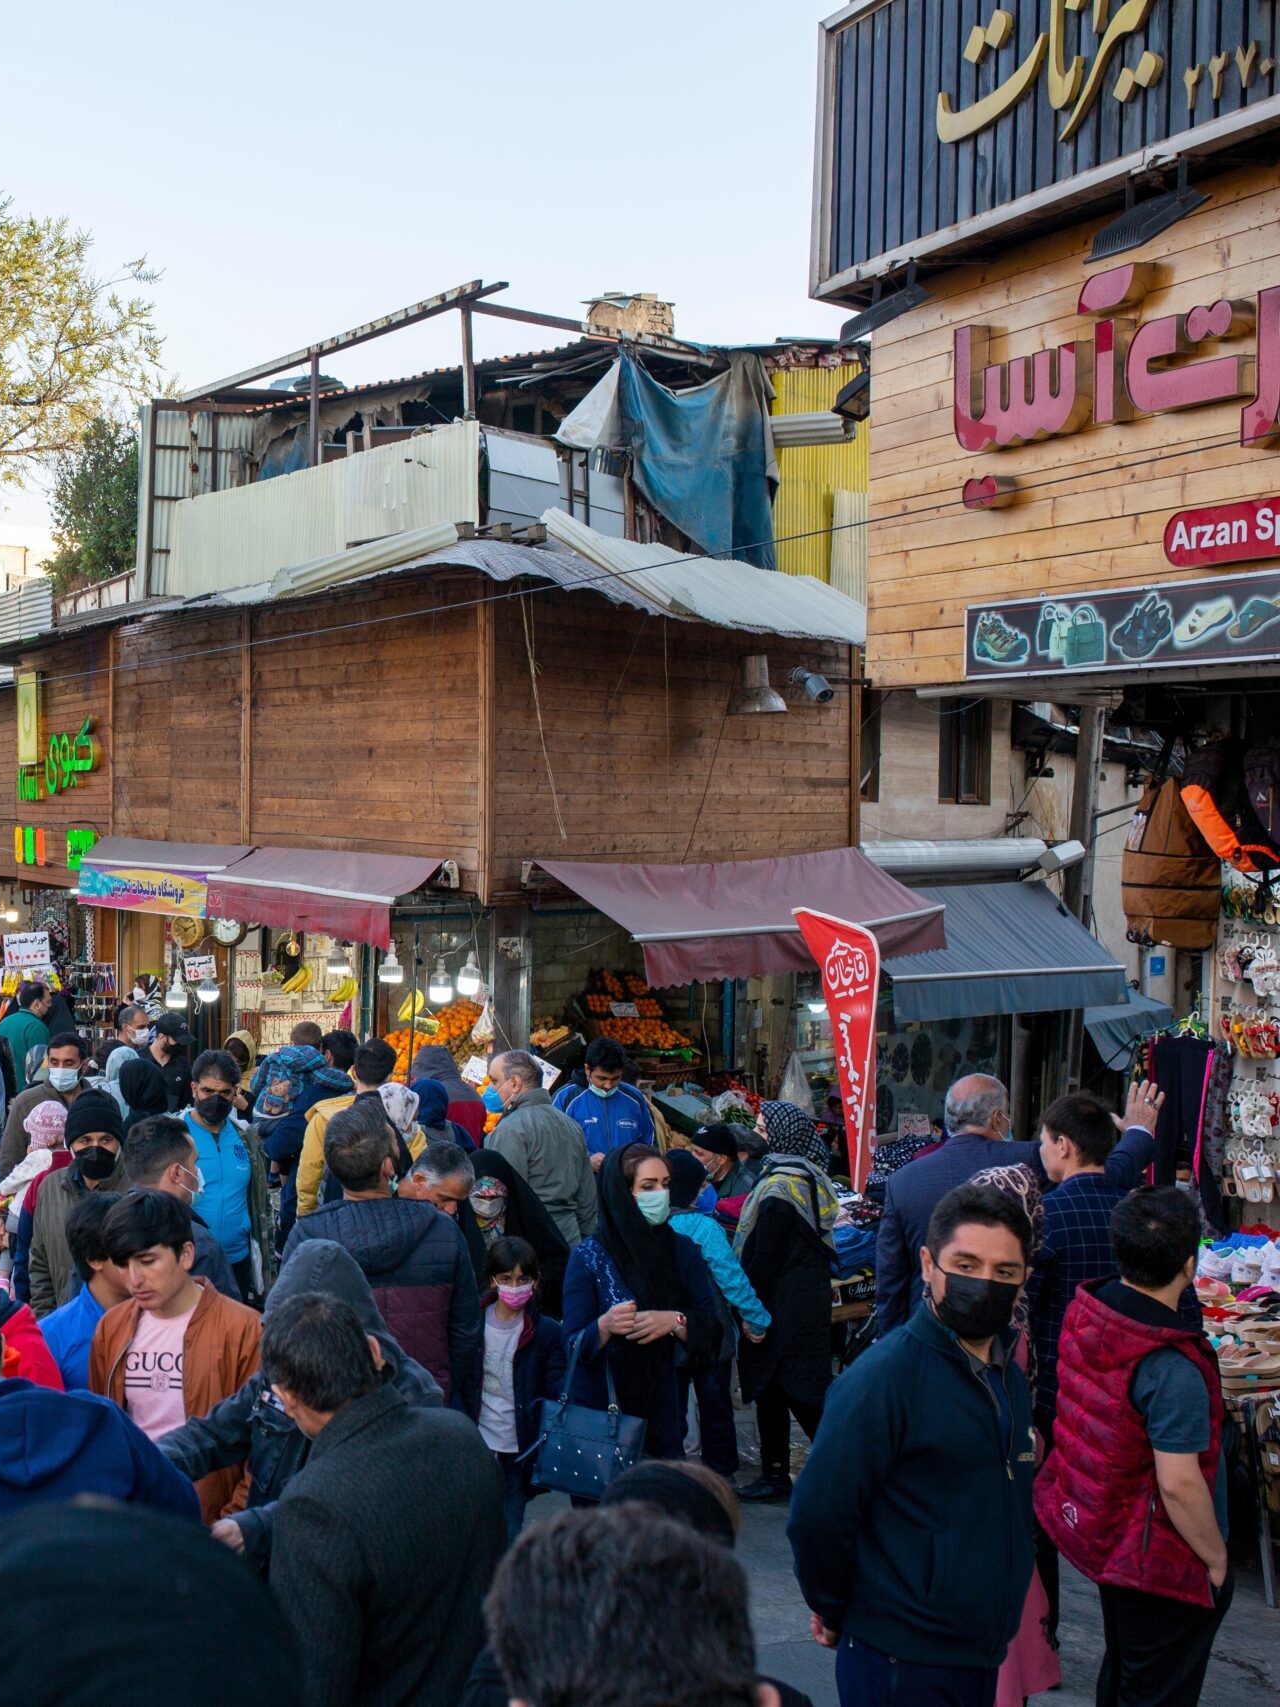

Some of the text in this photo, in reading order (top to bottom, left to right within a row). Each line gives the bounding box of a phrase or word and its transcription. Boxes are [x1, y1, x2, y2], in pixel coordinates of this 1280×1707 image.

[1170, 516, 1248, 554] Arzan
[45, 714, 94, 795] کیوی
[132, 880, 157, 902] بدلیجات
[158, 879, 185, 905] فروشگاه
[29, 935, 48, 945] جوراب
[186, 956, 213, 968] کمربند
